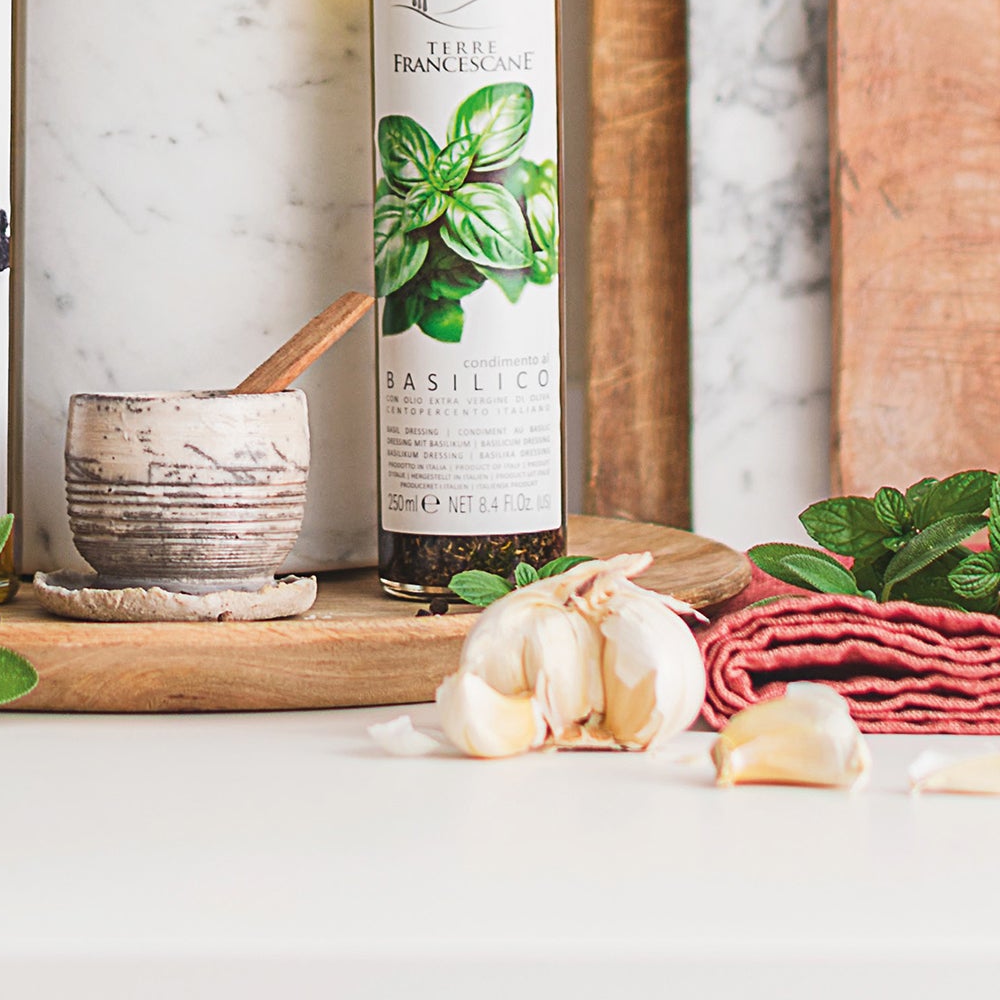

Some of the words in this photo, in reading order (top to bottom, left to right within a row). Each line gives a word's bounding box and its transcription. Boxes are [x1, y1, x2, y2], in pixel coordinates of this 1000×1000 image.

[426, 40, 497, 55] TERRE
[394, 53, 535, 73] FRANCESCANE
[463, 356, 539, 369] condimento
[540, 353, 550, 365] al
[387, 369, 549, 391] BASILICO
[403, 396, 423, 405] OLIO
[429, 397, 459, 405] EXTRA
[466, 396, 508, 405] VERGINE
[387, 405, 489, 416] CENTOPERCENTO
[498, 403, 550, 414] ITALIANO
[405, 427, 439, 436] DRESSING
[423, 451, 464, 460] DRESSING
[448, 495, 474, 513] NET
[479, 496, 498, 514] 8.4
